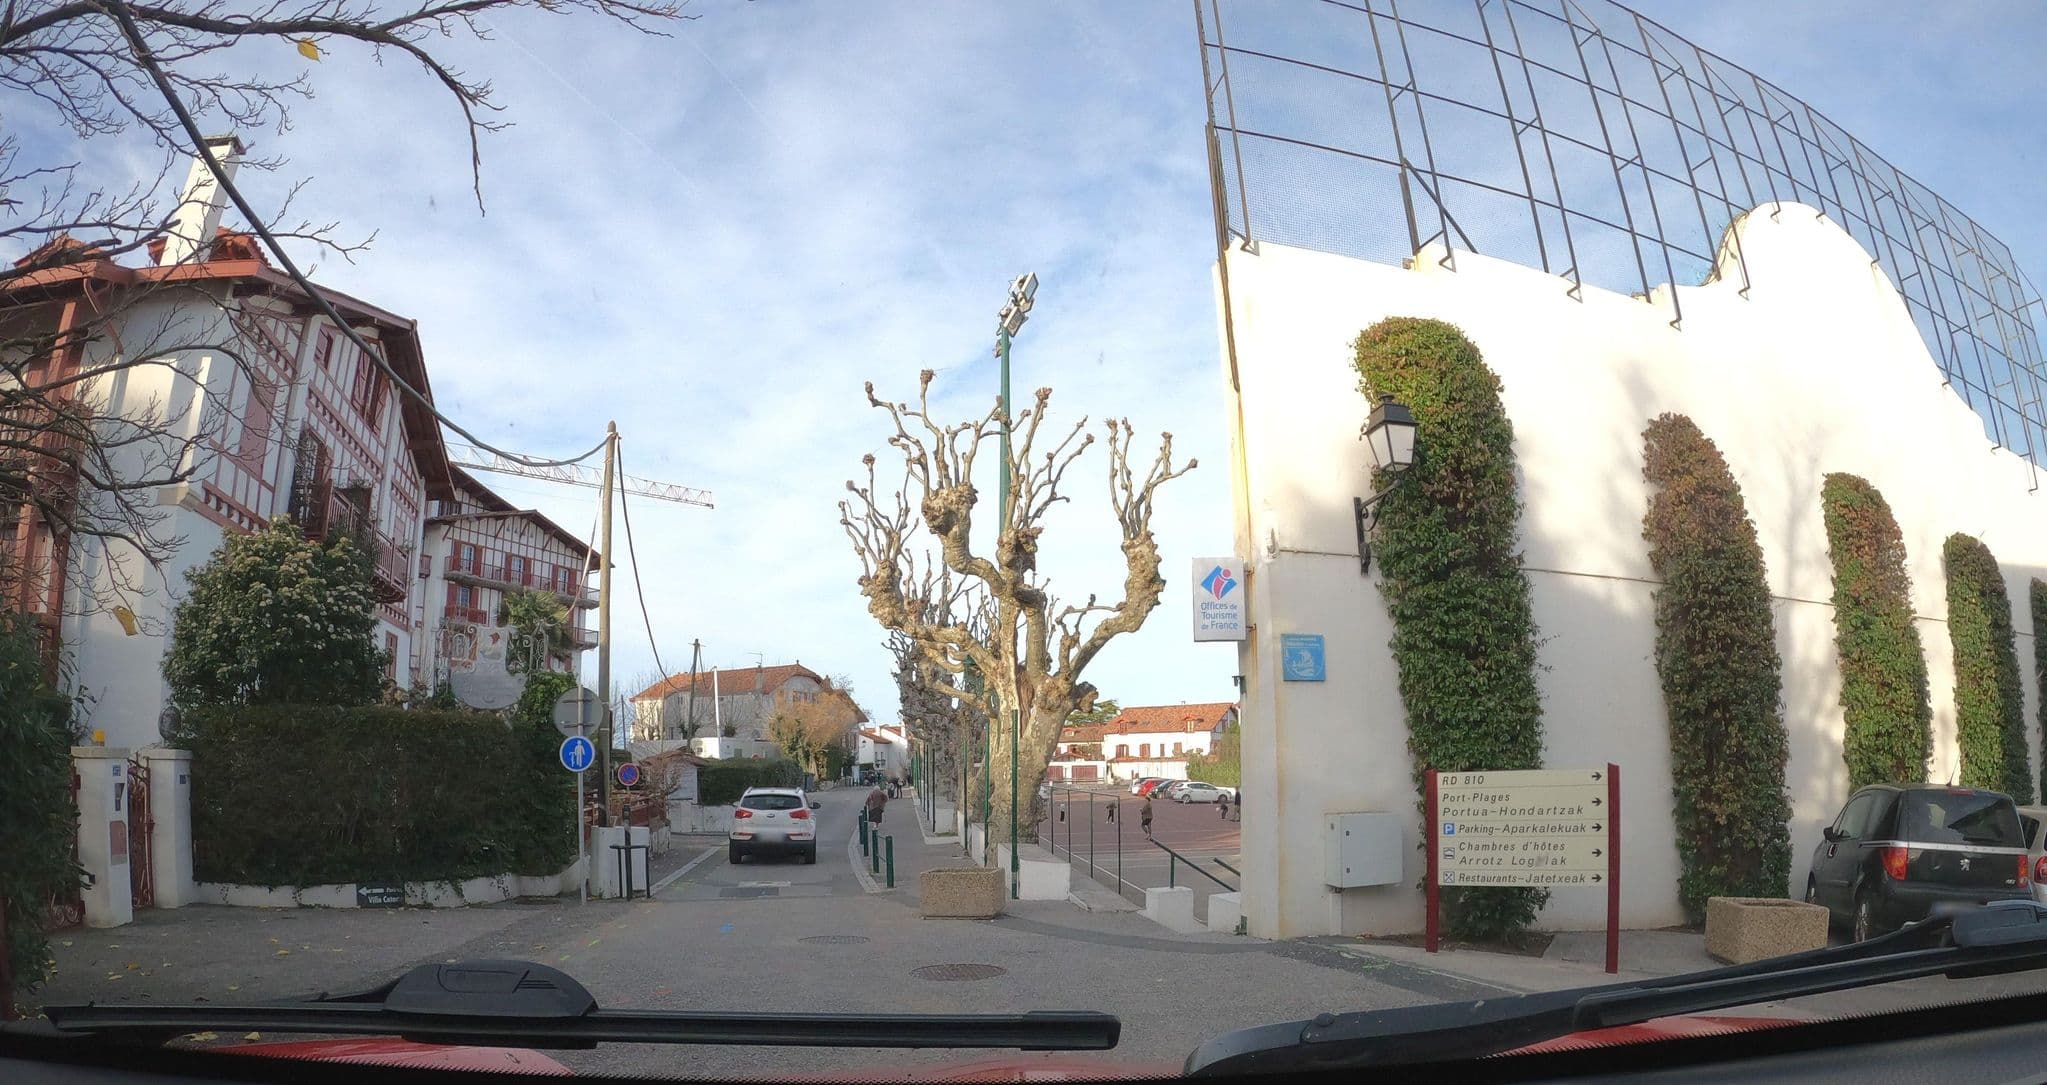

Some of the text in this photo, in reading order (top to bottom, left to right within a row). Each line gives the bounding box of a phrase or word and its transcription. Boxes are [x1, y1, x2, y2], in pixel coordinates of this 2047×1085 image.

[1201, 602, 1228, 610] Offices
[1201, 611, 1238, 619] Tourisme
[1210, 621, 1238, 629] France
[1442, 775, 1485, 785] RD 810
[1442, 792, 1511, 804] Port-Plages
[1442, 805, 1584, 817] Portua-Hondartzak
[1458, 822, 1587, 835] Parking-Aparkalekuak
[1459, 841, 1566, 851] Chambres d'hôtes
[1459, 855, 1567, 867] Arrotz Loglak
[1458, 872, 1586, 884] Restaurants-Jatetxeak
